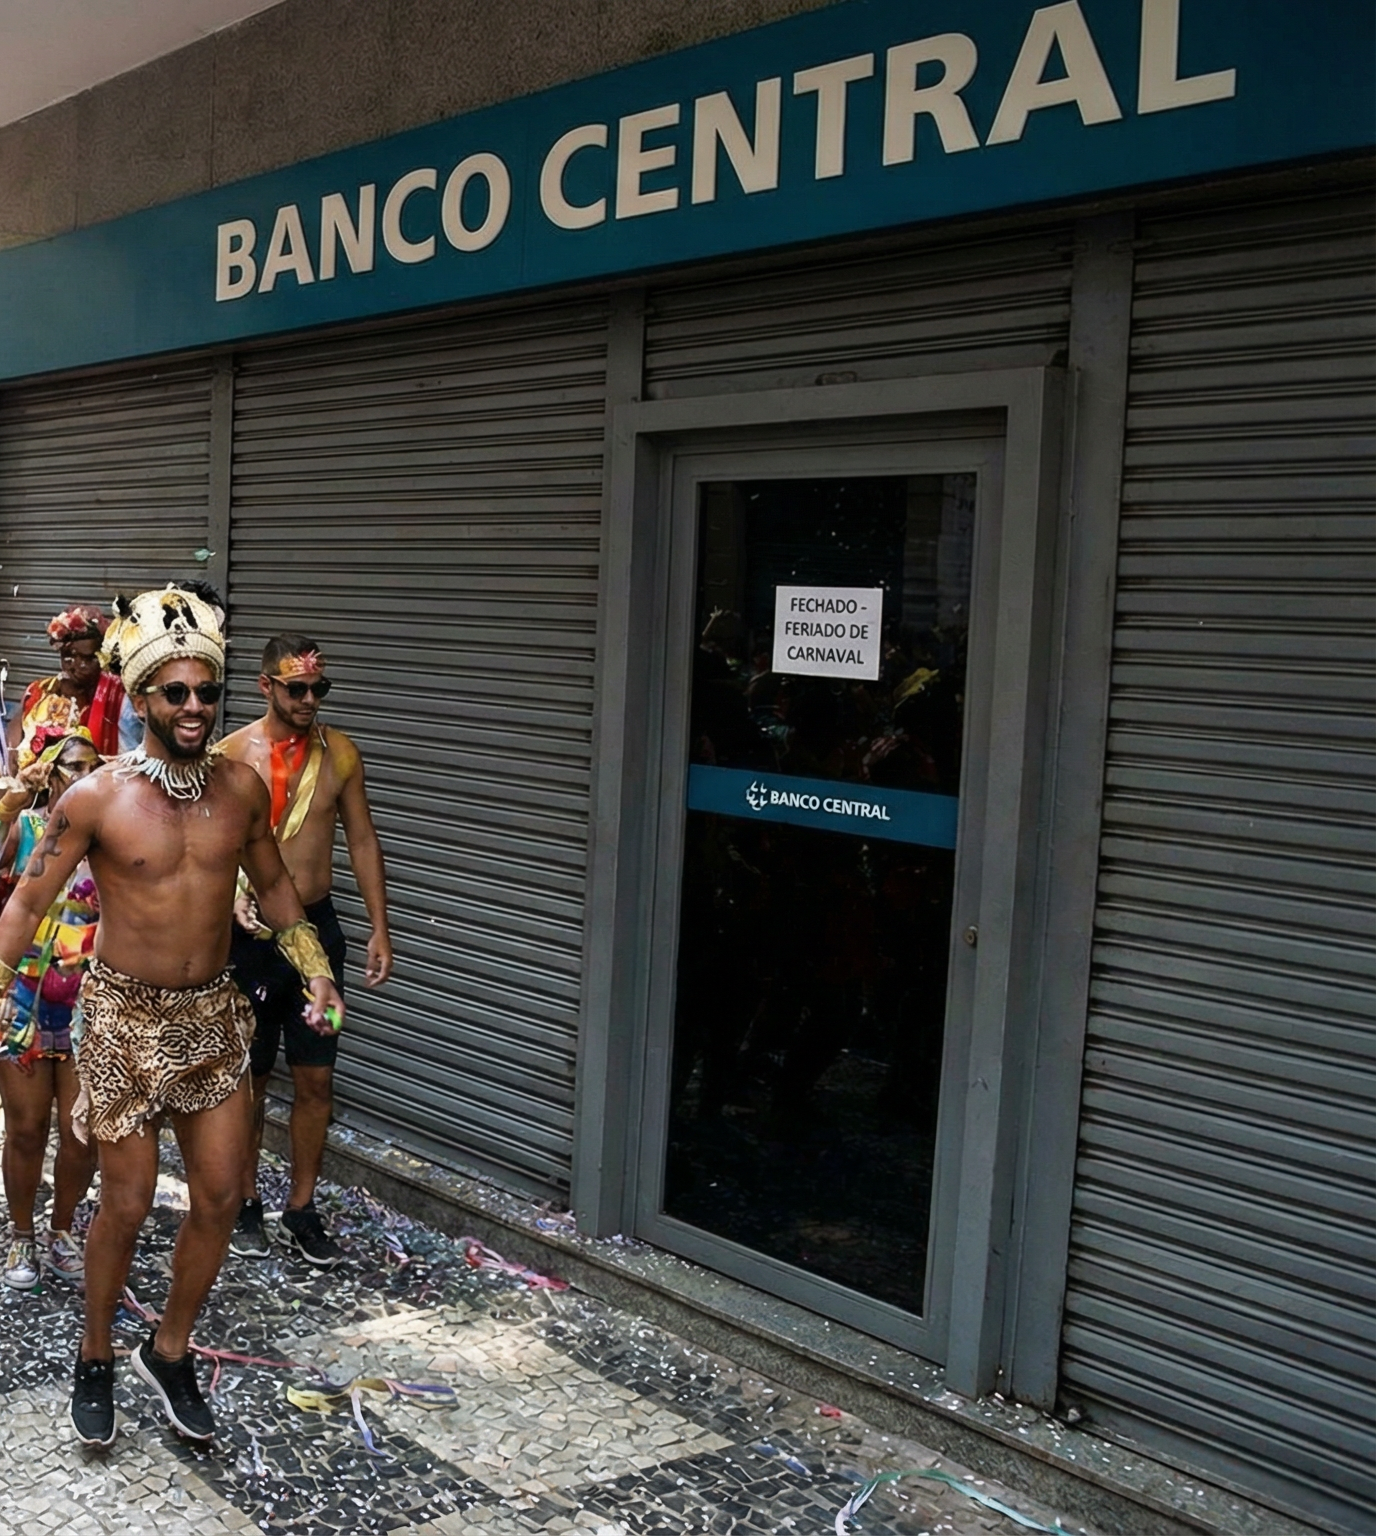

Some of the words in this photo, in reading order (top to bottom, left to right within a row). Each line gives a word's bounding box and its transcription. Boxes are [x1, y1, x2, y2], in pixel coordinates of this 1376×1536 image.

[215, 152, 512, 302] BANCO
[539, 0, 1237, 231] CENTRAL
[790, 597, 857, 613] FECHADO
[785, 621, 846, 639] FERIADO
[849, 623, 869, 640] DE
[787, 646, 864, 664] CARNAVAL
[770, 790, 820, 811] BANCO
[823, 797, 890, 820] CENTRAL
